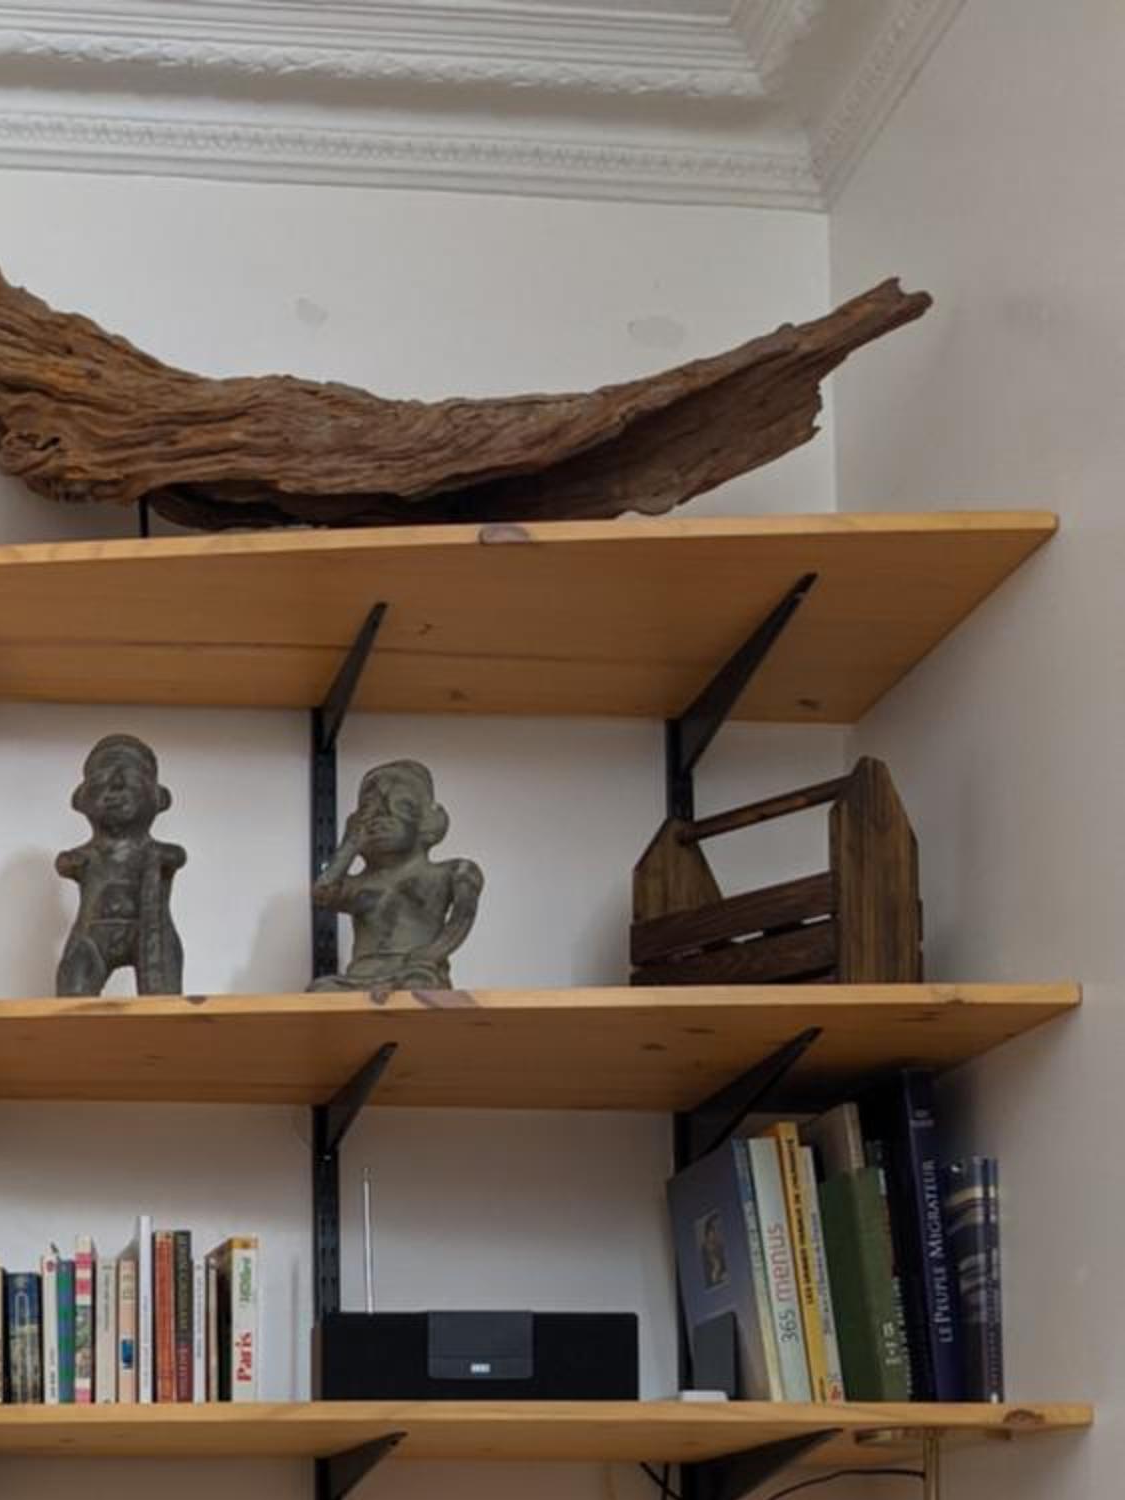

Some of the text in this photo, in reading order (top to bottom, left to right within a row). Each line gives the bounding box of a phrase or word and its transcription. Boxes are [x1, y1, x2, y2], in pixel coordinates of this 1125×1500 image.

[922, 1160, 945, 1259] MIGRATEUR
[768, 1222, 796, 1302] menus
[235, 1332, 252, 1381] Paris
[778, 1308, 800, 1344] 365
